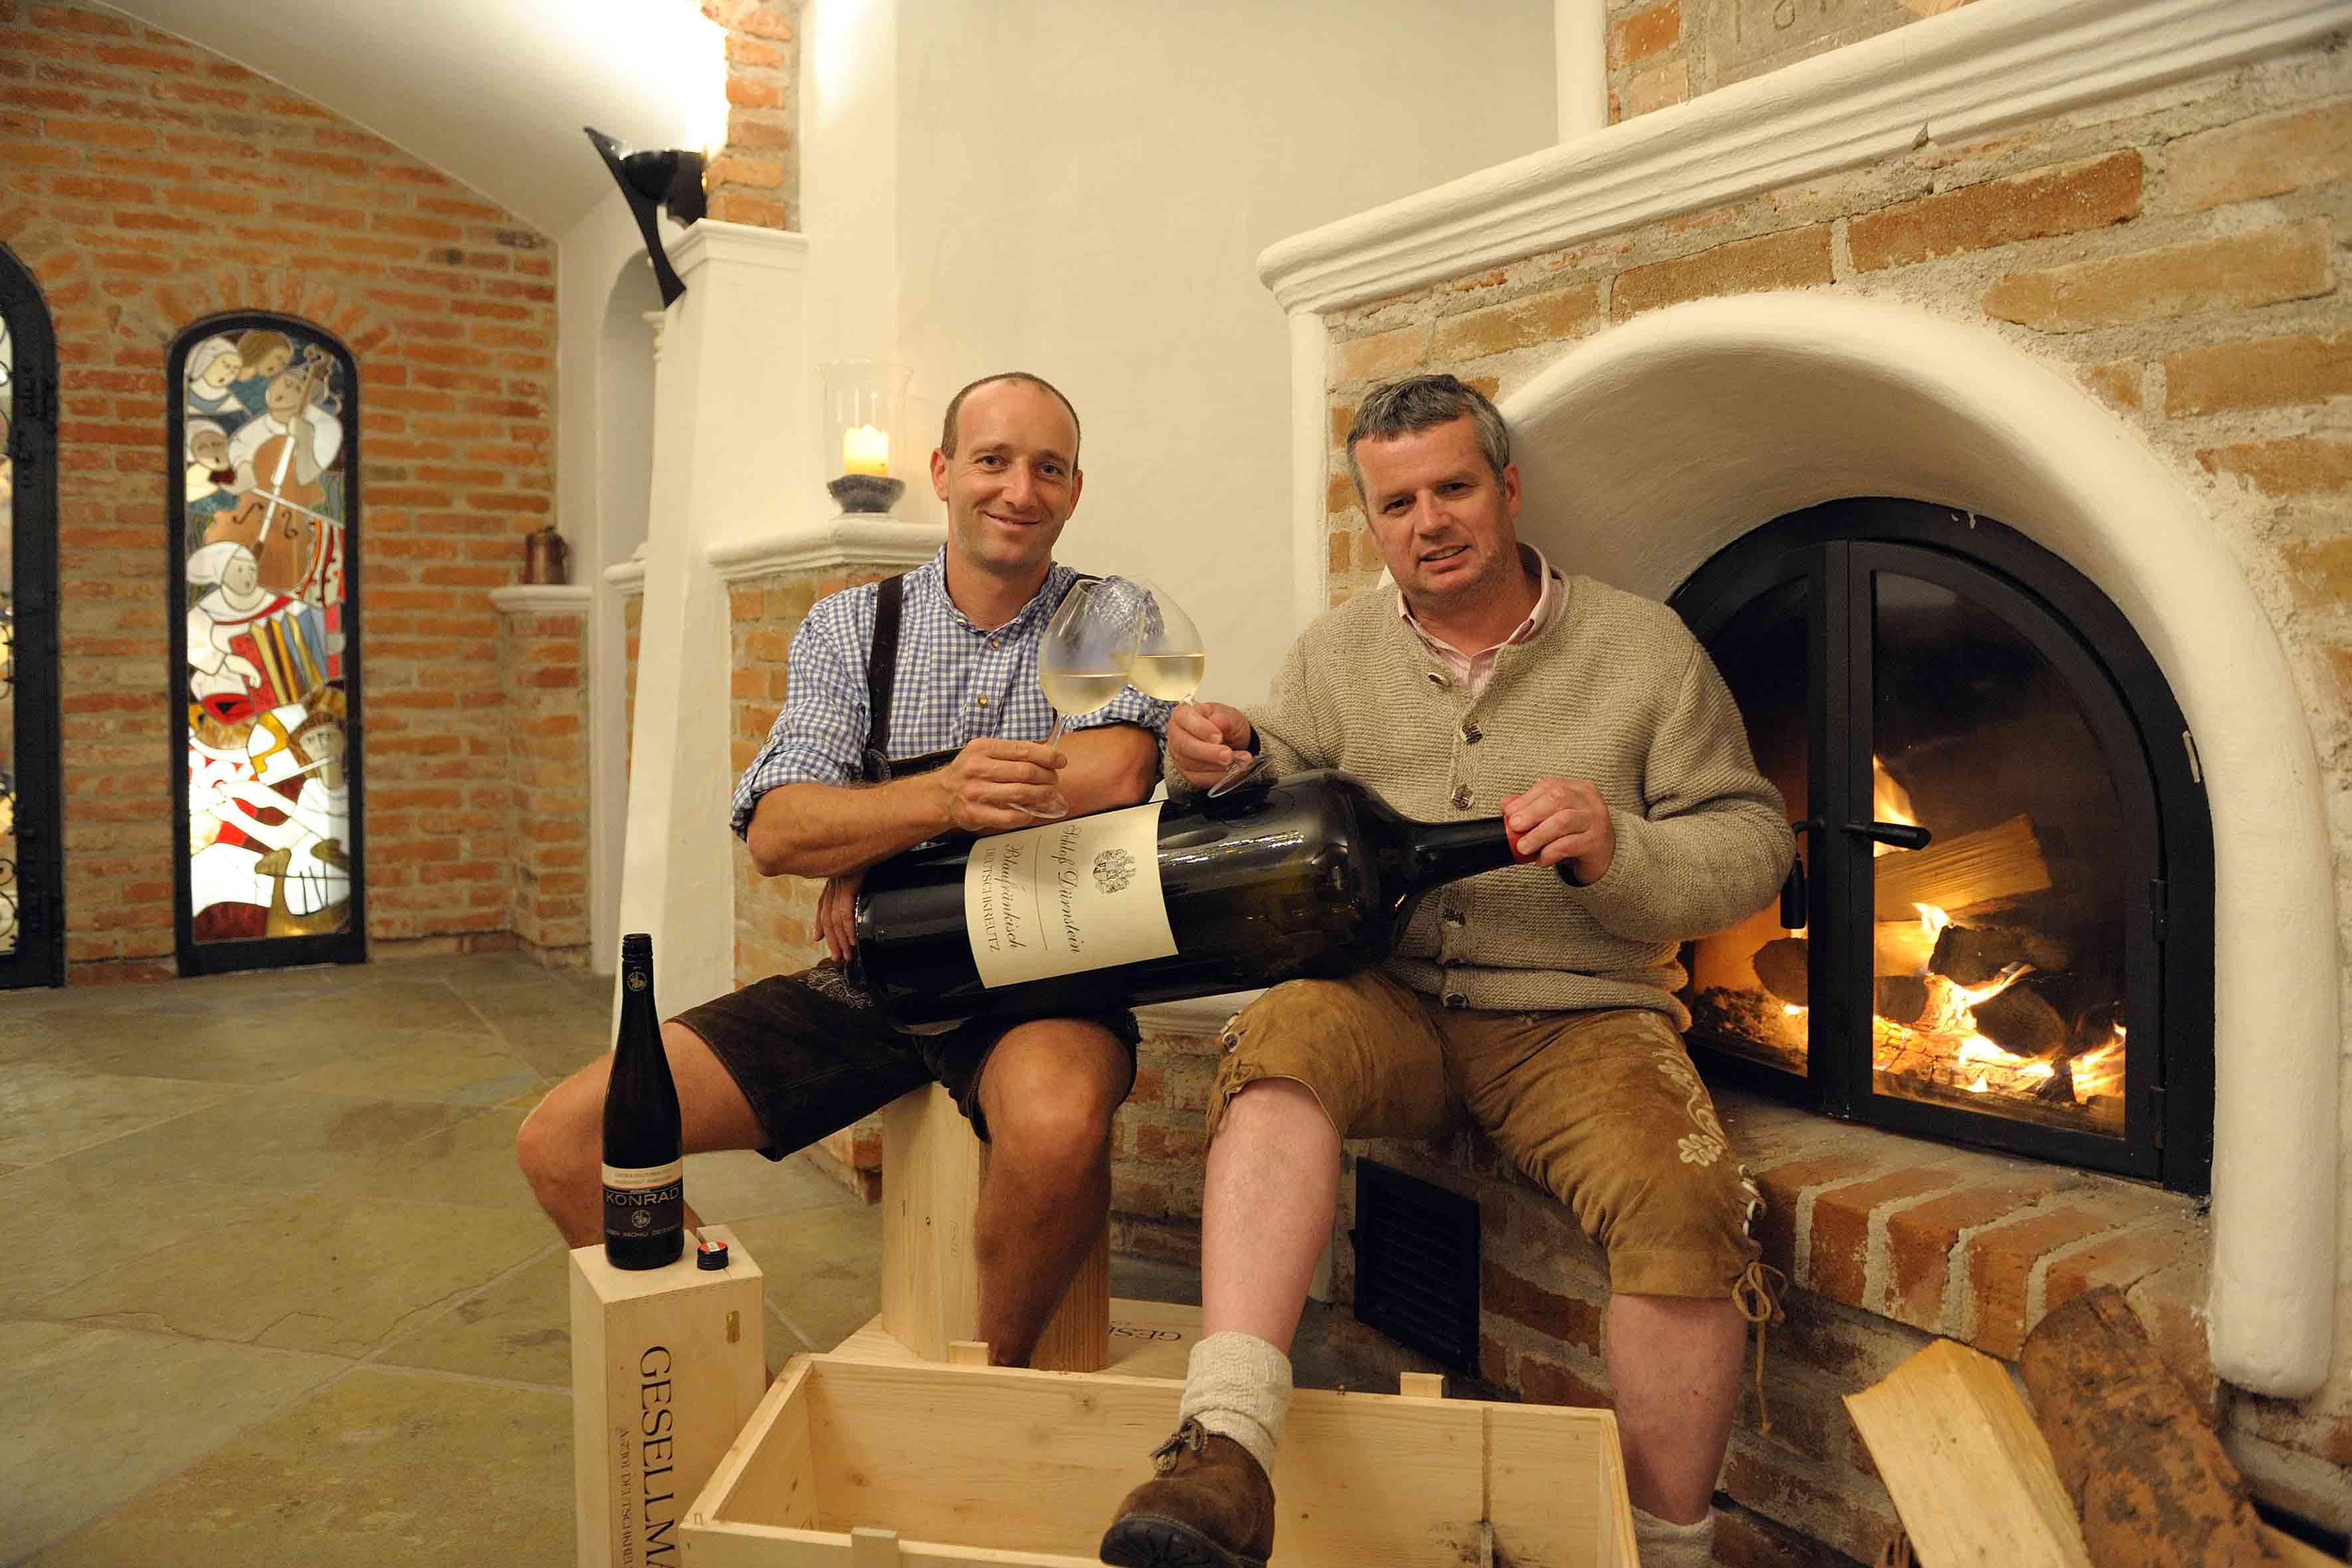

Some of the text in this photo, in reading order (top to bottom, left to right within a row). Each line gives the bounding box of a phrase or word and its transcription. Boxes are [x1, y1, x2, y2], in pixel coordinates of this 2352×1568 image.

[994, 842, 1026, 950] Blaufränkisch
[1058, 870, 1084, 953] Dürnstein
[606, 1188, 679, 1206] KONRAD
